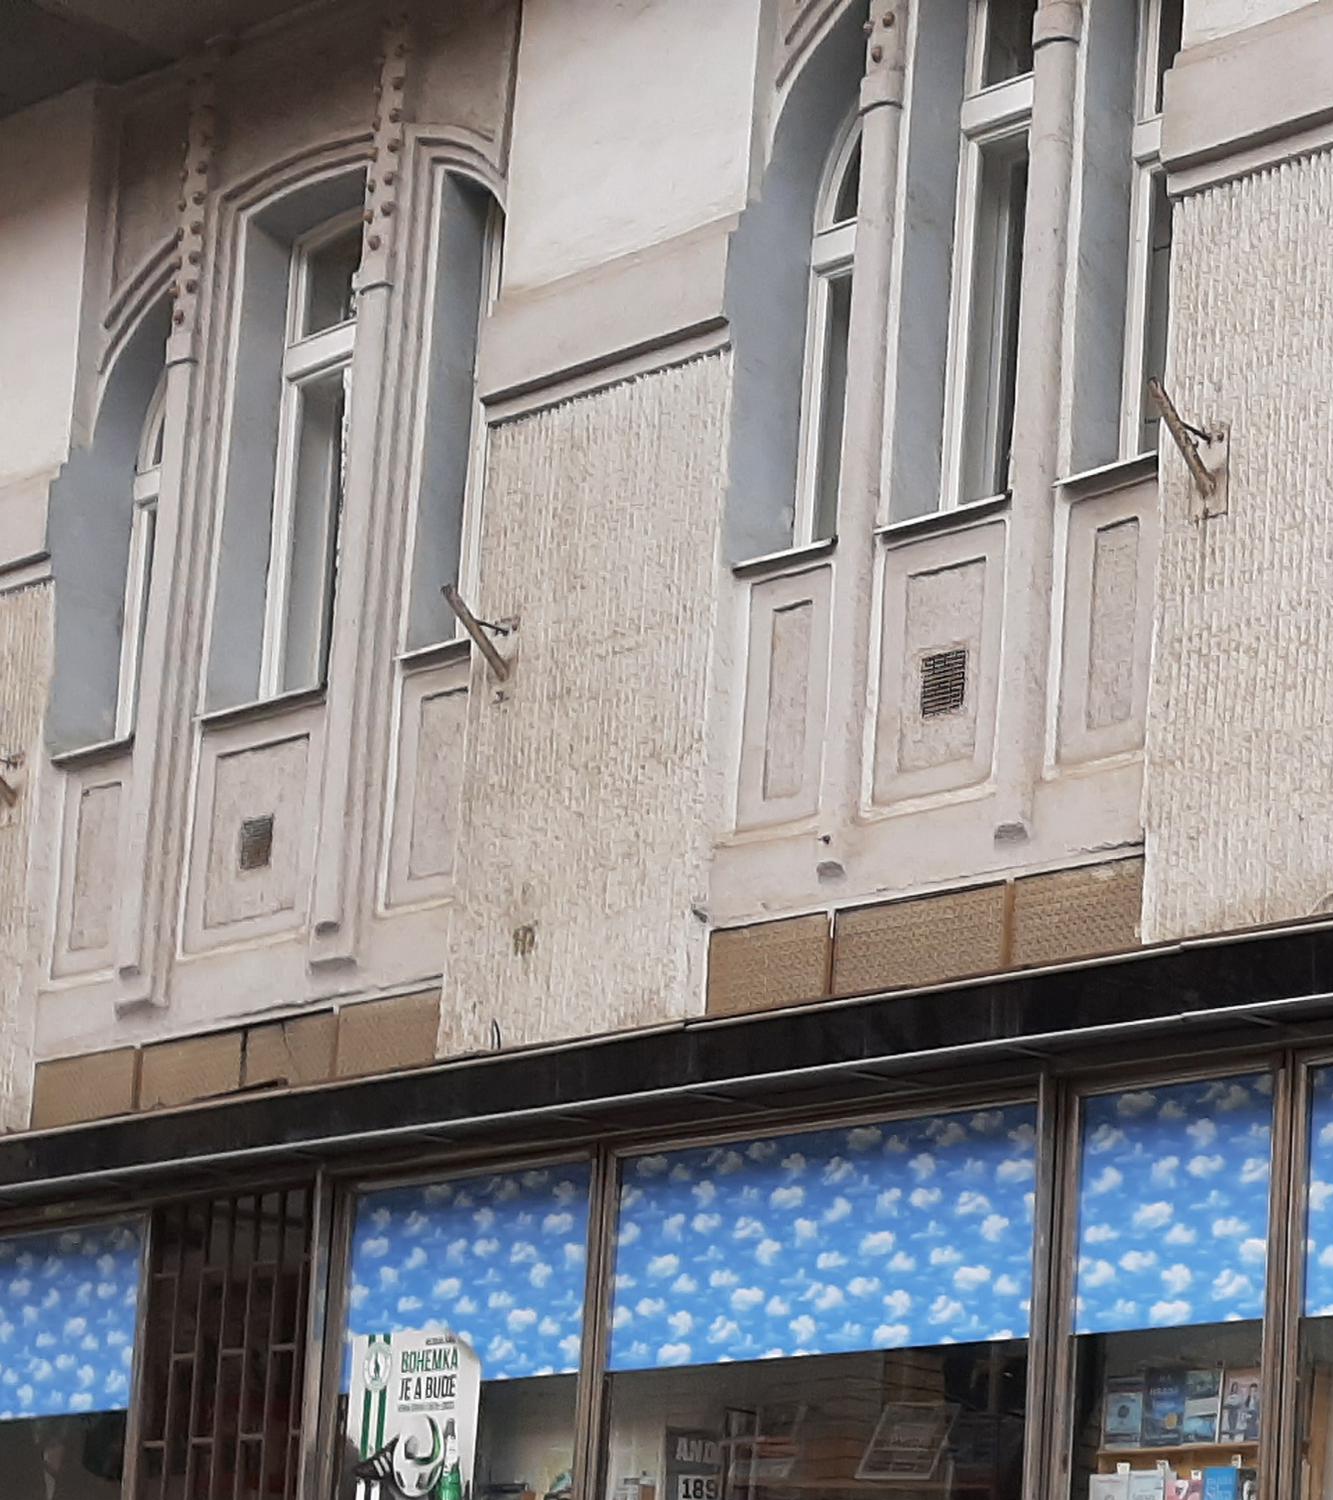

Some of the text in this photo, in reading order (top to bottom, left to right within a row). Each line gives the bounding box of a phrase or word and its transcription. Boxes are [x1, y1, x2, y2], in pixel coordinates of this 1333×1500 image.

[401, 1347, 458, 1373] BOHEMKA
[413, 1377, 422, 1400] A
[425, 1374, 457, 1399] BUDE
